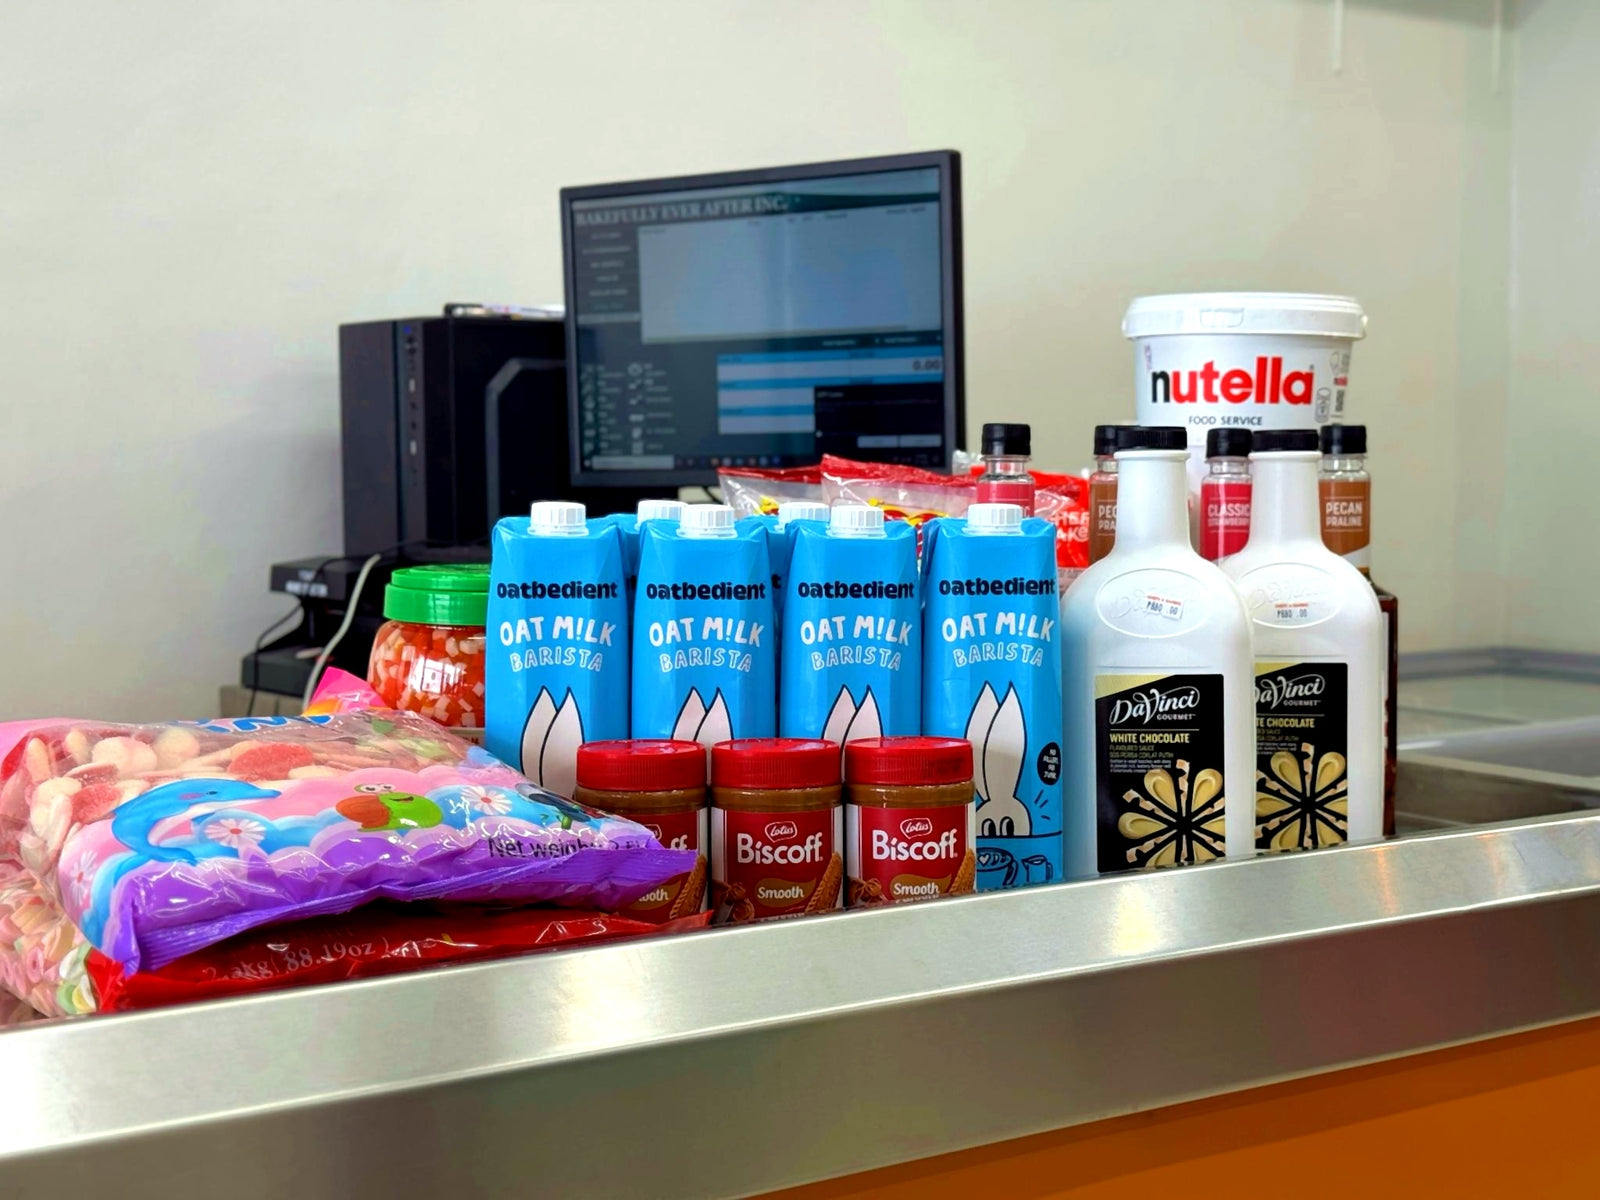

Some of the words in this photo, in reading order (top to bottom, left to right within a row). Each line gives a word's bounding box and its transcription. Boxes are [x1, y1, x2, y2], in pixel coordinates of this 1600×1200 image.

[660, 201, 701, 220] EVER
[1151, 356, 1314, 405] nutella
[1188, 415, 1217, 426] FOOD
[1220, 415, 1263, 427] SERVICE
[1098, 504, 1118, 519] PEC
[1325, 501, 1363, 516] PECAN
[1325, 515, 1363, 527] PRALINE
[497, 581, 618, 599] oatbedient
[646, 582, 766, 600] oatbedient
[798, 580, 915, 599] oatbedient
[938, 577, 1056, 596] oatbedient
[500, 617, 544, 646] OAT
[649, 617, 694, 647] OAT
[801, 616, 846, 646] OAT
[942, 613, 987, 643] OAT
[510, 646, 603, 672] BARISTA
[660, 647, 753, 673] BARISTA
[811, 645, 901, 671] BARISTA
[953, 642, 1044, 668] BARISTA
[1109, 686, 1200, 725] DaVinci
[1156, 713, 1193, 721] GOURMET
[1266, 717, 1316, 728] CHOCOLATE
[1109, 733, 1138, 743] WHITE
[1139, 733, 1190, 743] CHOCOLATE
[770, 826, 795, 837] Lotus
[905, 822, 931, 834] Lotus
[488, 837, 525, 858] Net
[737, 832, 823, 864] Biscoff
[872, 829, 957, 860] Biscoff
[638, 888, 669, 902] ooth
[757, 885, 805, 900] Smooth
[893, 880, 940, 896] Smooth
